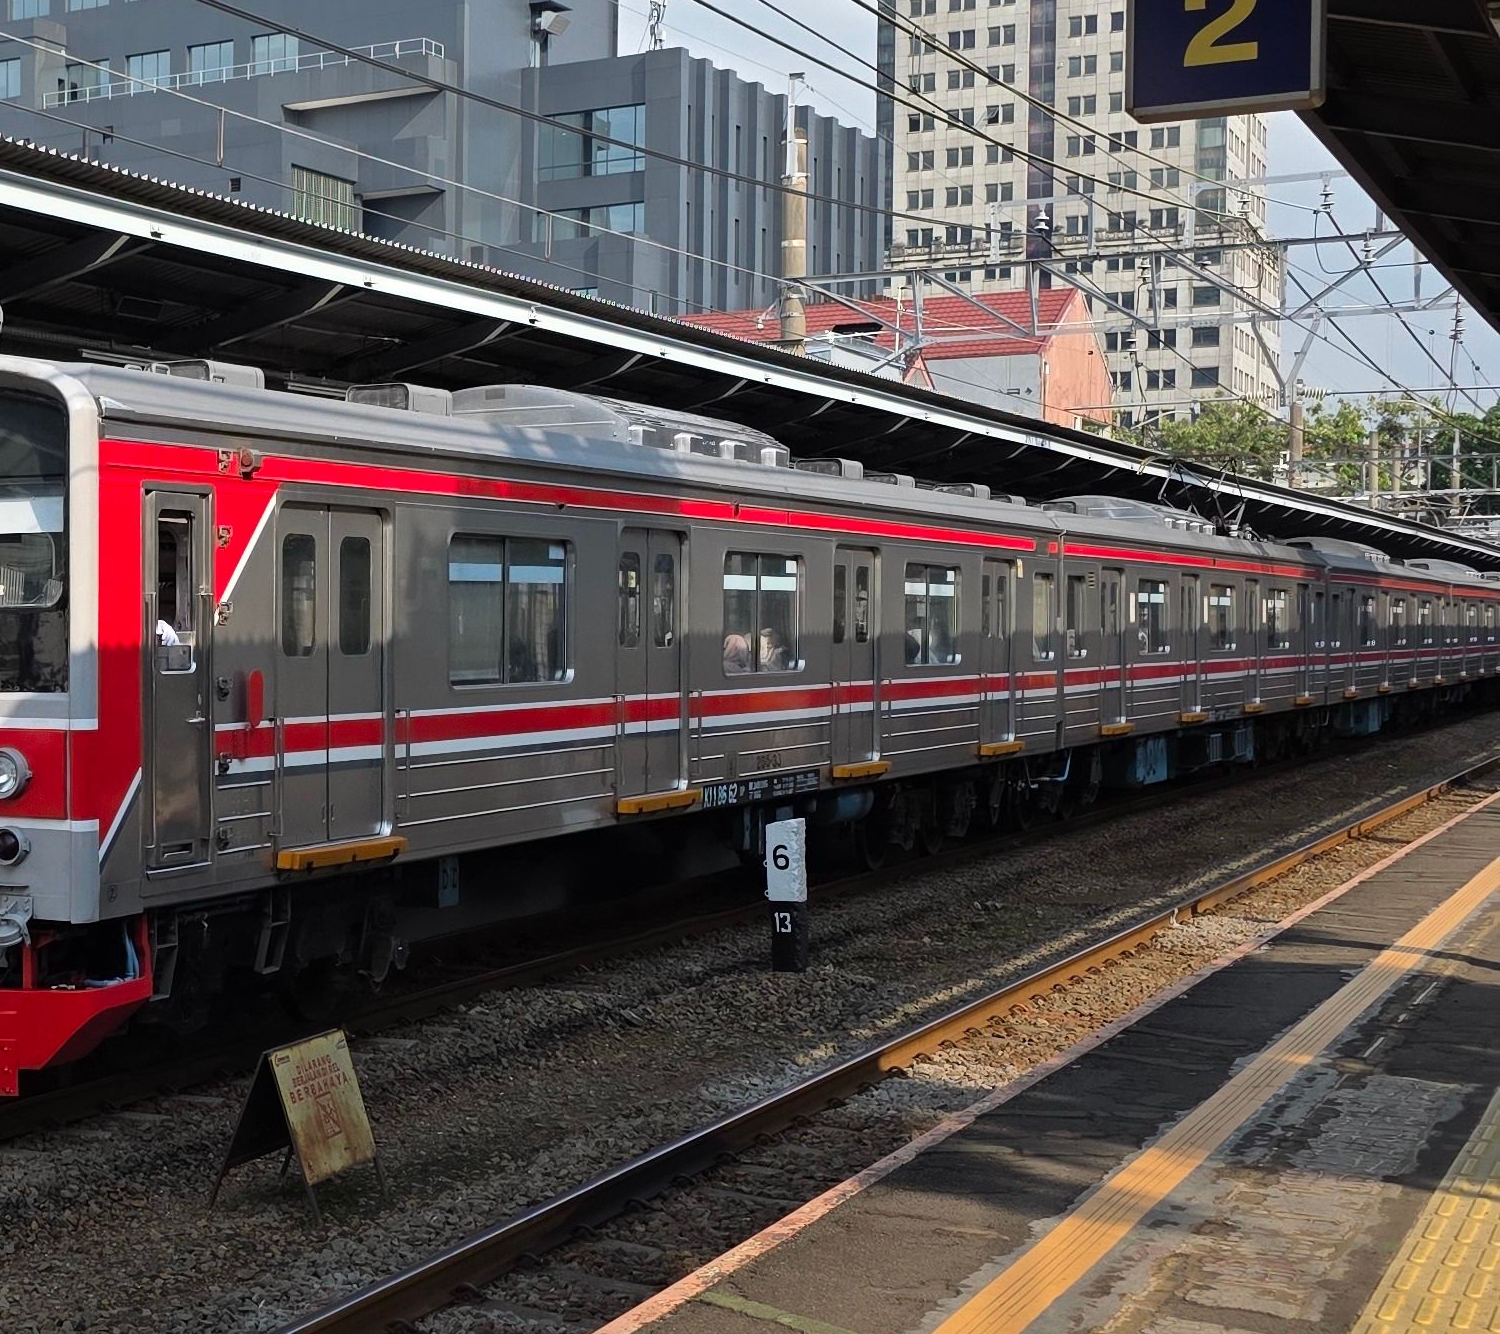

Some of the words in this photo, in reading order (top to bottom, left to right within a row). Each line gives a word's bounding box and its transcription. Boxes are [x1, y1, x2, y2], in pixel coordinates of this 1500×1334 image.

[772, 844, 790, 870] 6
[774, 912, 792, 933] 13
[295, 1053, 332, 1075] DILARANG
